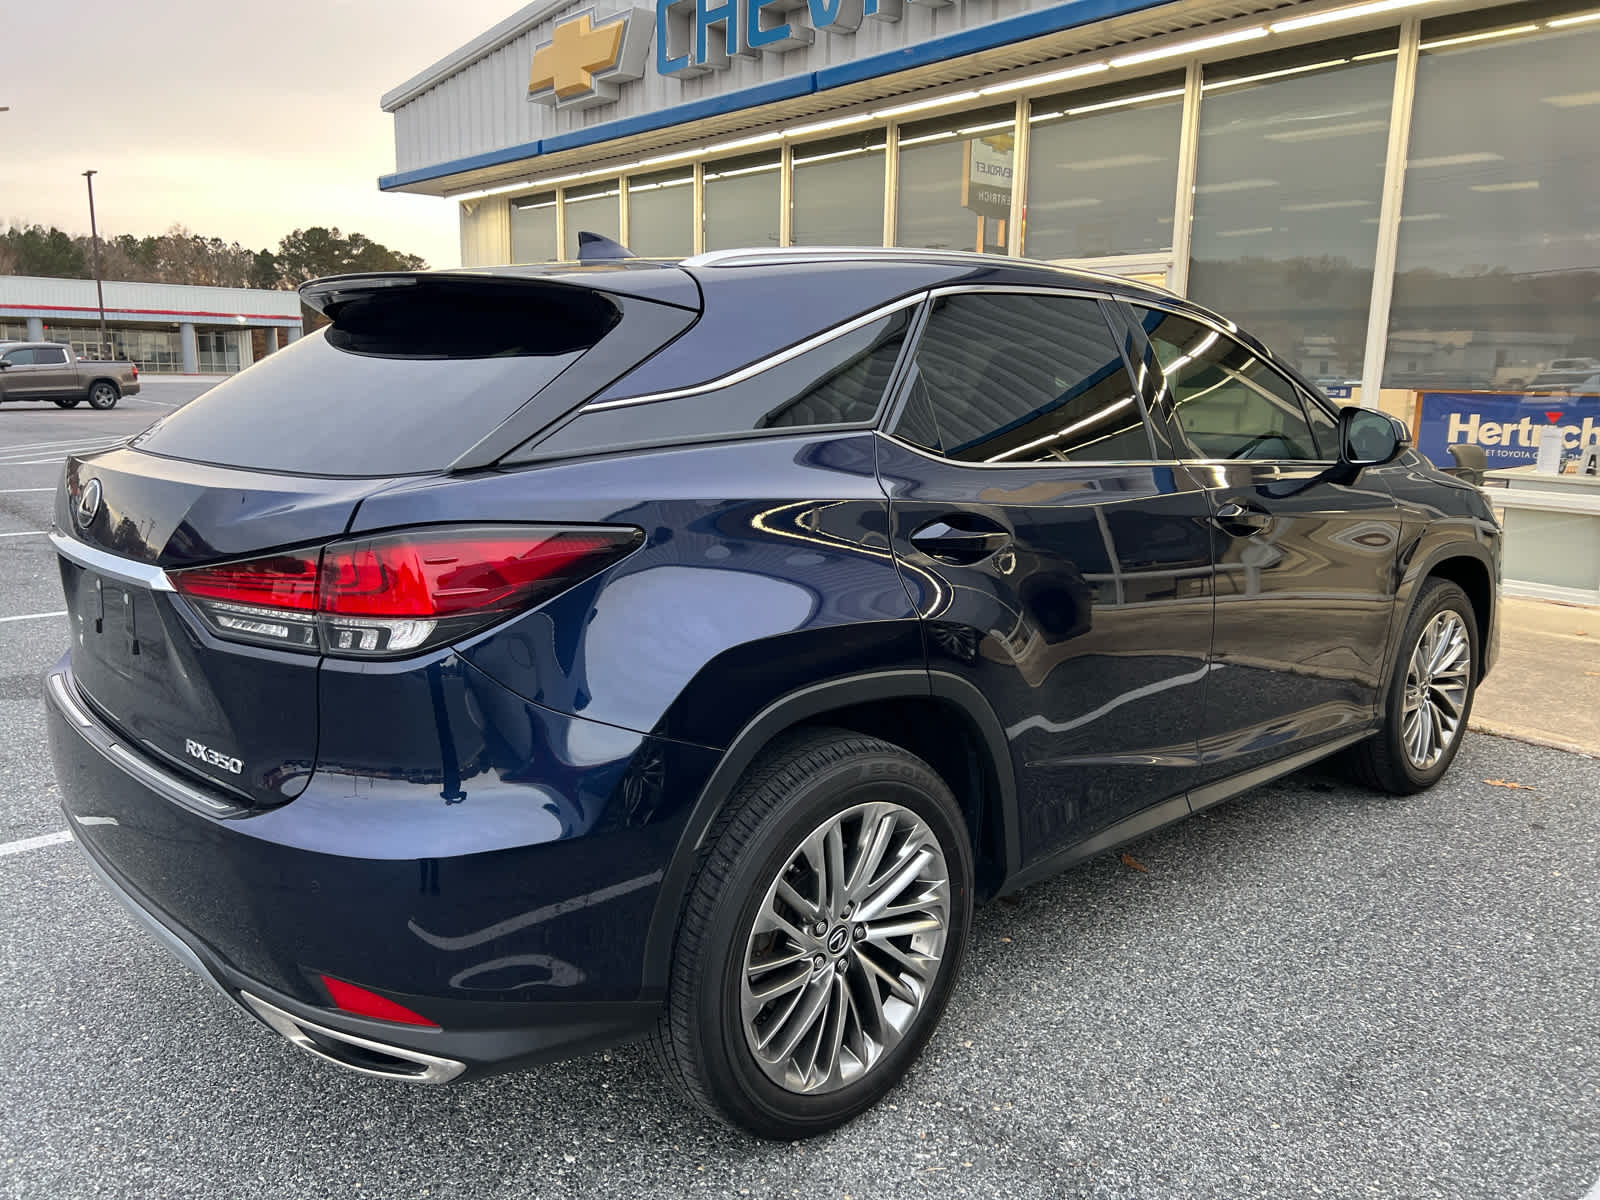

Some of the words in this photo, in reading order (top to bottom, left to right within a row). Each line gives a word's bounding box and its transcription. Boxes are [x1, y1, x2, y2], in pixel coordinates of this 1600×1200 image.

[1448, 413, 1600, 450] Hertrch
[1497, 450, 1531, 459] TOYOTA
[185, 738, 243, 775] RX350
